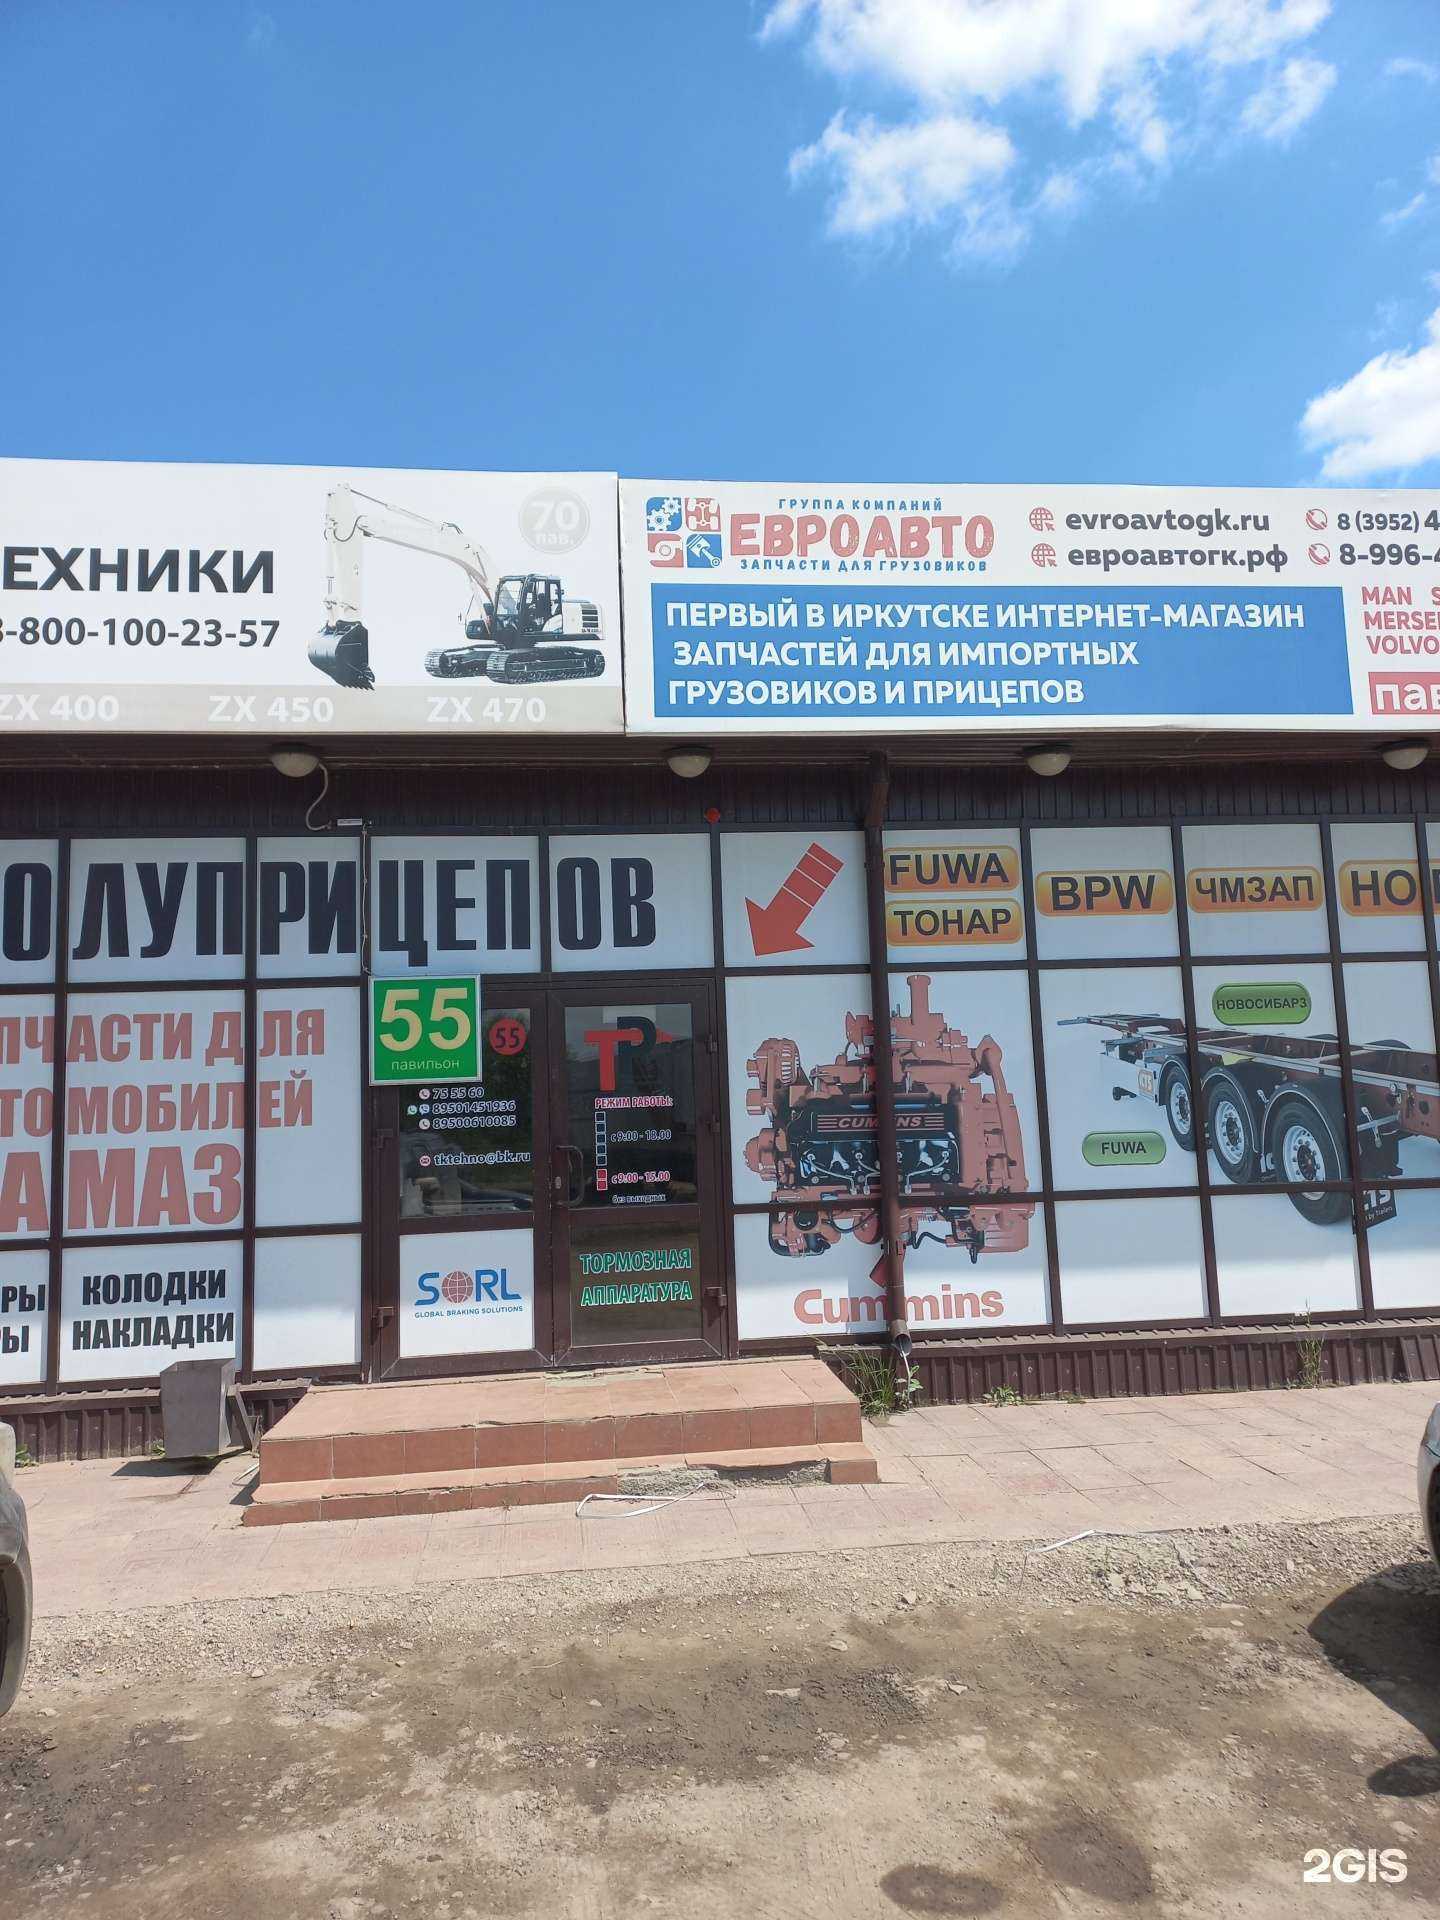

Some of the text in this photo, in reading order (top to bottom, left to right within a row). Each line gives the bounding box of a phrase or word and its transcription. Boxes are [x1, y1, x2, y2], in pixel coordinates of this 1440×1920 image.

[530, 500, 578, 531] 70
[779, 498, 943, 511] ГРУППА КОМПАНИЙ
[1065, 509, 1269, 536] evroavtogk.ru
[1337, 513, 1350, 530] 8
[1355, 511, 1419, 533] (3952)
[730, 513, 994, 559] ЕВРОАВТО
[3, 546, 273, 593] ЕХНИКИ
[741, 559, 986, 572] ЗАПЧАСТИ ДЛЯ ГРУЗОВИКОВ
[1068, 544, 1287, 572] евроавтогк.рф
[1361, 586, 1412, 605] MAN
[667, 596, 1305, 628] ПЕРВЫЙ В ИРКУТСКЕ ИНТЕРНЕТ-МАГАЗИН
[1364, 611, 1440, 630] MERSE
[0, 616, 280, 647] -800-100-23-57
[1366, 635, 1440, 654] VOLVO
[673, 636, 1139, 669] ЗАПЧАСТЕЙ ДЛЯ ИМПОРТНЫХ
[669, 680, 1084, 707] ГРУЗОВИКОВ И ПРИЦЕПОВ
[49, 695, 119, 721] 400
[208, 695, 334, 723] ZX 450
[426, 697, 547, 723] ZX 470
[889, 853, 1009, 886] FUWA
[1051, 876, 1156, 911] BPW
[1195, 876, 1314, 902] ЧМЗАП
[893, 908, 1011, 936] ТОНАР
[1216, 998, 1308, 1010] НОВОСИБАРЗ
[380, 988, 471, 1052] 55
[205, 1009, 325, 1066] ДЛЯ
[495, 1027, 520, 1048] 55
[391, 1059, 460, 1071] павильон
[432, 1087, 484, 1099] 75 55 60
[595, 1097, 630, 1109] РЕЖИМ
[432, 1100, 516, 1114] 89501451936
[432, 1115, 516, 1129] 89500610085
[838, 1117, 921, 1128] CUMNS
[434, 1150, 530, 1166] tktehno@bk.ru
[1101, 1142, 1147, 1155] FUWA
[0, 1143, 241, 1232] АМАЗ
[580, 1248, 692, 1274] ТОРМОЗНАЯ
[1, 1284, 46, 1313] РЫ
[82, 1269, 226, 1306] КОЛОДКИ
[580, 1281, 692, 1306] АППАРАТУРА
[415, 1306, 523, 1319] GLOBAL BRAKING SOLUTIONS
[0, 1325, 29, 1354] Ы
[72, 1312, 234, 1350] НАКЛАДКИ
